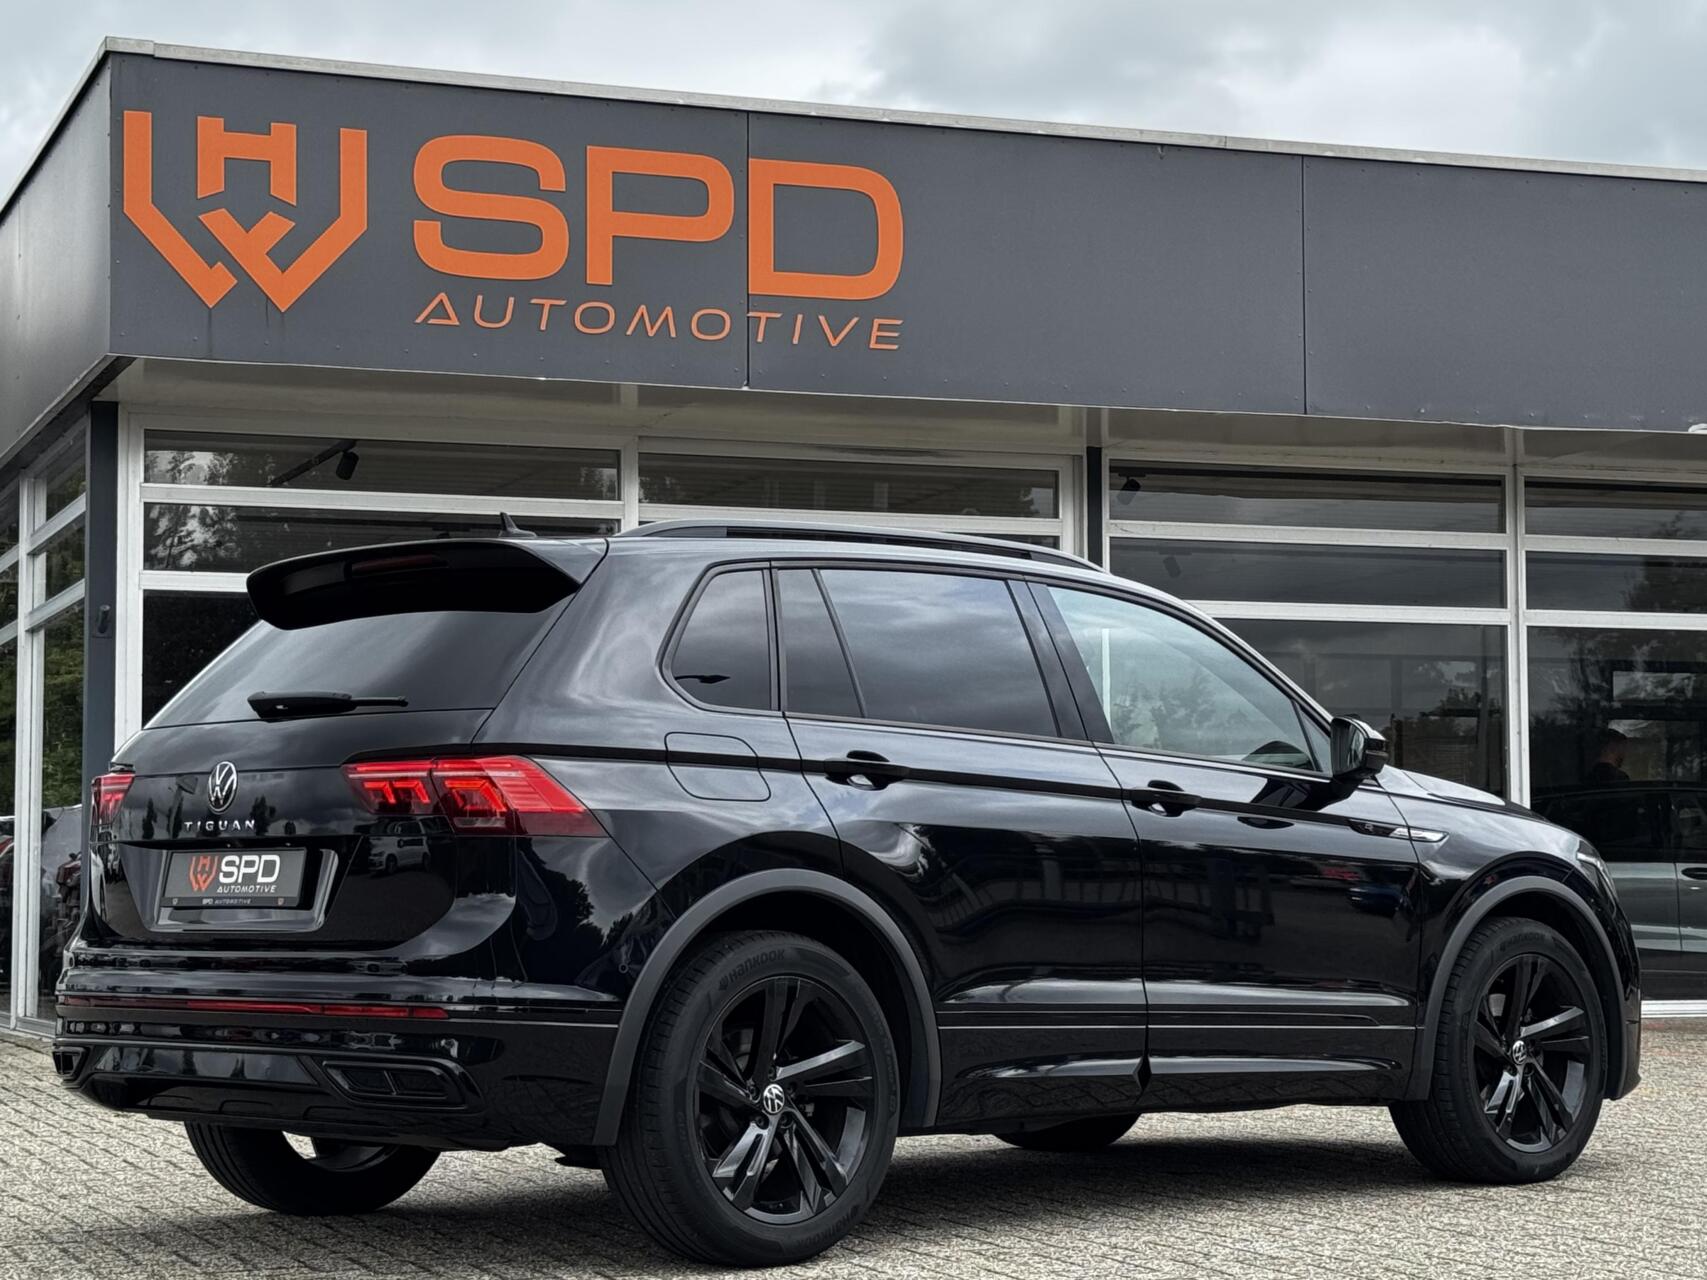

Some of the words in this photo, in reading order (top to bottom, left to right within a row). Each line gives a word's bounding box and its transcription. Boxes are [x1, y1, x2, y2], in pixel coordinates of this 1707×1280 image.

[413, 134, 904, 301] SPD
[415, 292, 904, 351] AUTOMOTIVE
[184, 820, 255, 832] TIGUAN
[219, 855, 281, 884] SPD
[216, 885, 277, 893] AUTOMOTIVE
